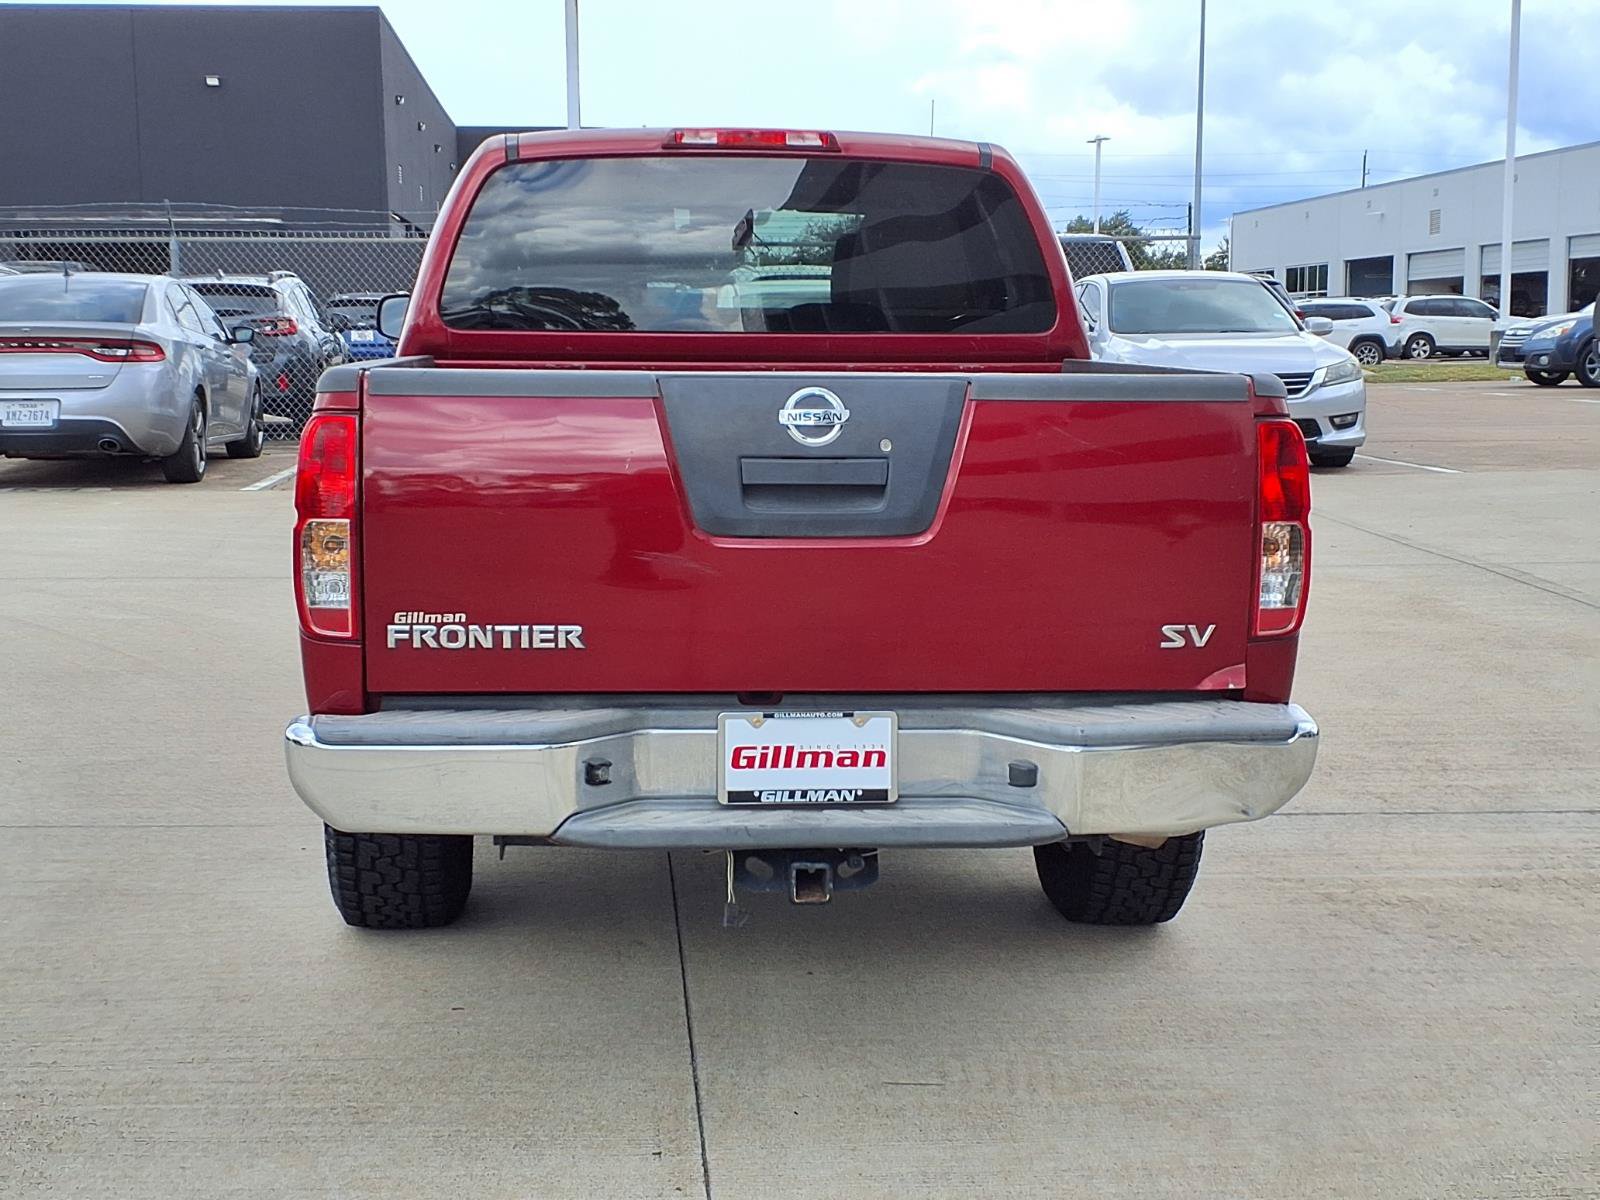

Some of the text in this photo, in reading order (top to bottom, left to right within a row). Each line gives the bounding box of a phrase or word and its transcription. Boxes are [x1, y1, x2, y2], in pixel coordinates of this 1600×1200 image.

[787, 412, 842, 422] NISSAN
[394, 611, 467, 624] Gillman
[387, 624, 586, 649] FRONTIER
[1160, 624, 1217, 648] SV
[773, 711, 844, 719] GILLMANAUTO.COM
[730, 745, 887, 770] Gillman
[760, 790, 857, 803] GILLMAN
